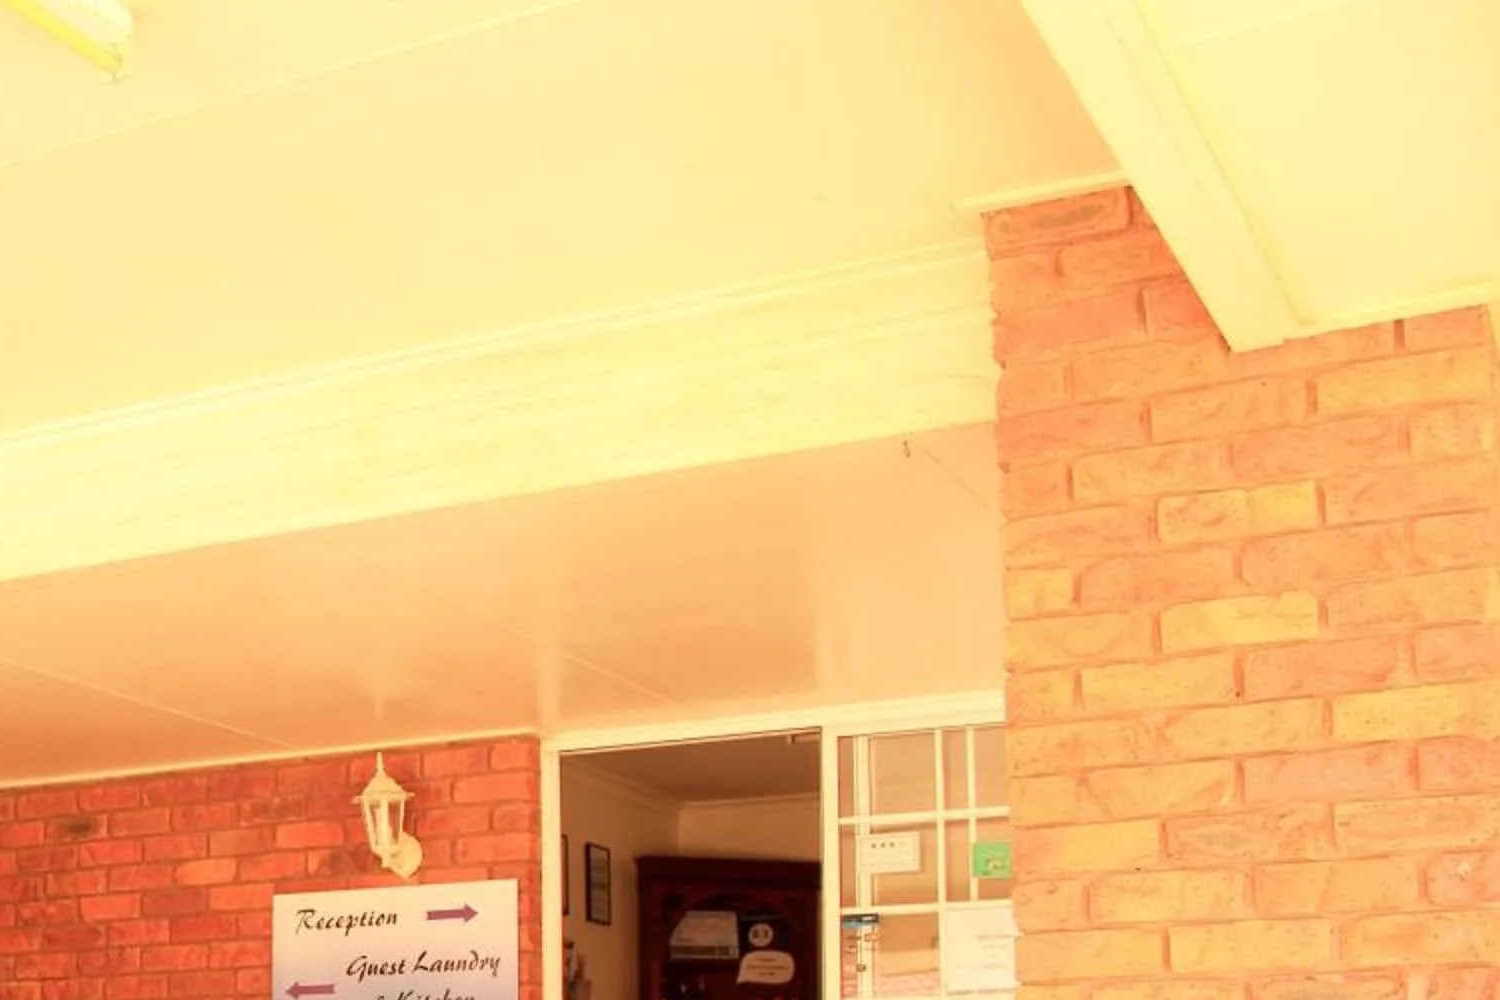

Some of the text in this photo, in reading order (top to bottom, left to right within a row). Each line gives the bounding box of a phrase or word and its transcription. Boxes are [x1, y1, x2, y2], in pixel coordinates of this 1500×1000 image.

[295, 909, 398, 936] Reception
[346, 950, 501, 982] Guest Laundry
